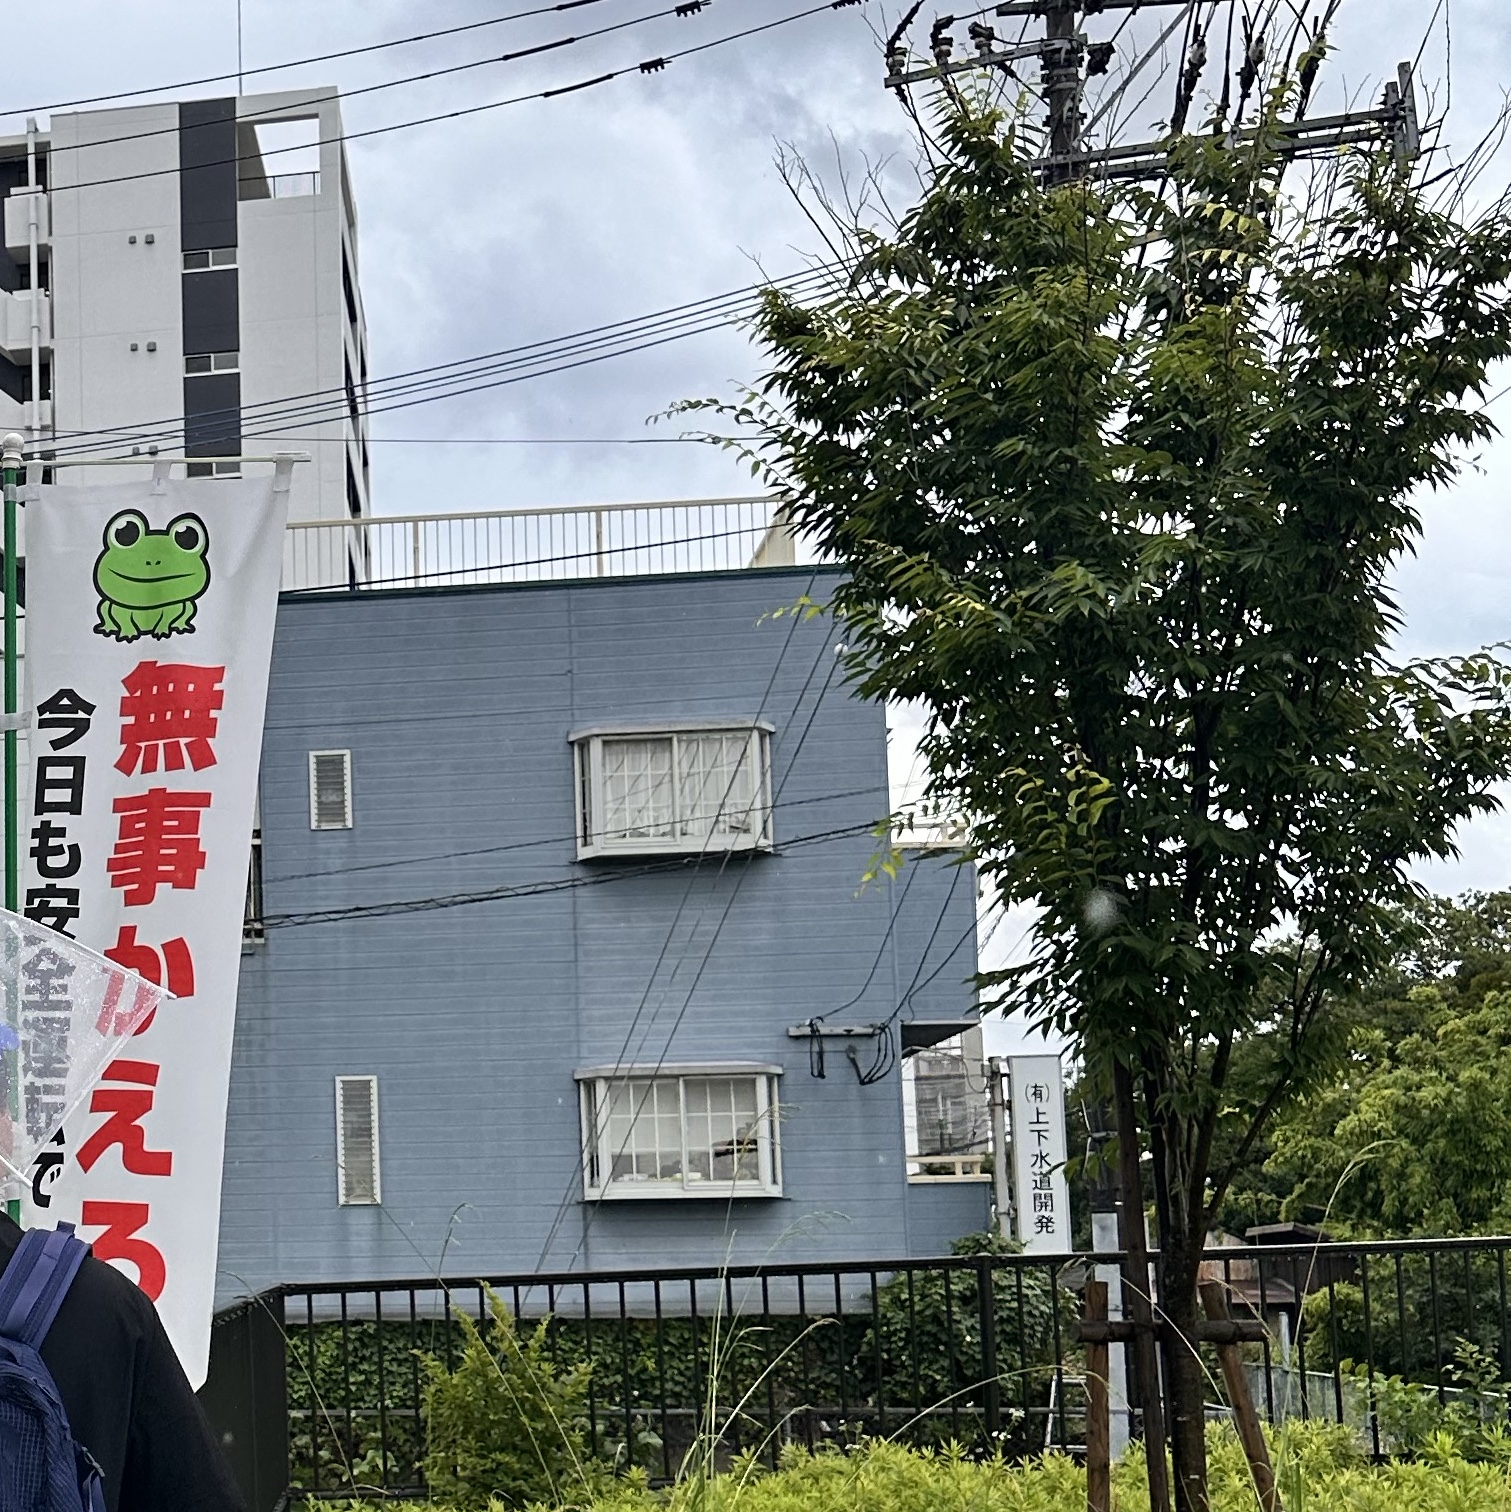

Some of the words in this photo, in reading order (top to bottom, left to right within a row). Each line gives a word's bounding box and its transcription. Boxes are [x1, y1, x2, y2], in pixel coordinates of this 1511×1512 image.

[1024, 1083, 1056, 1235] (有)上下水道開発
